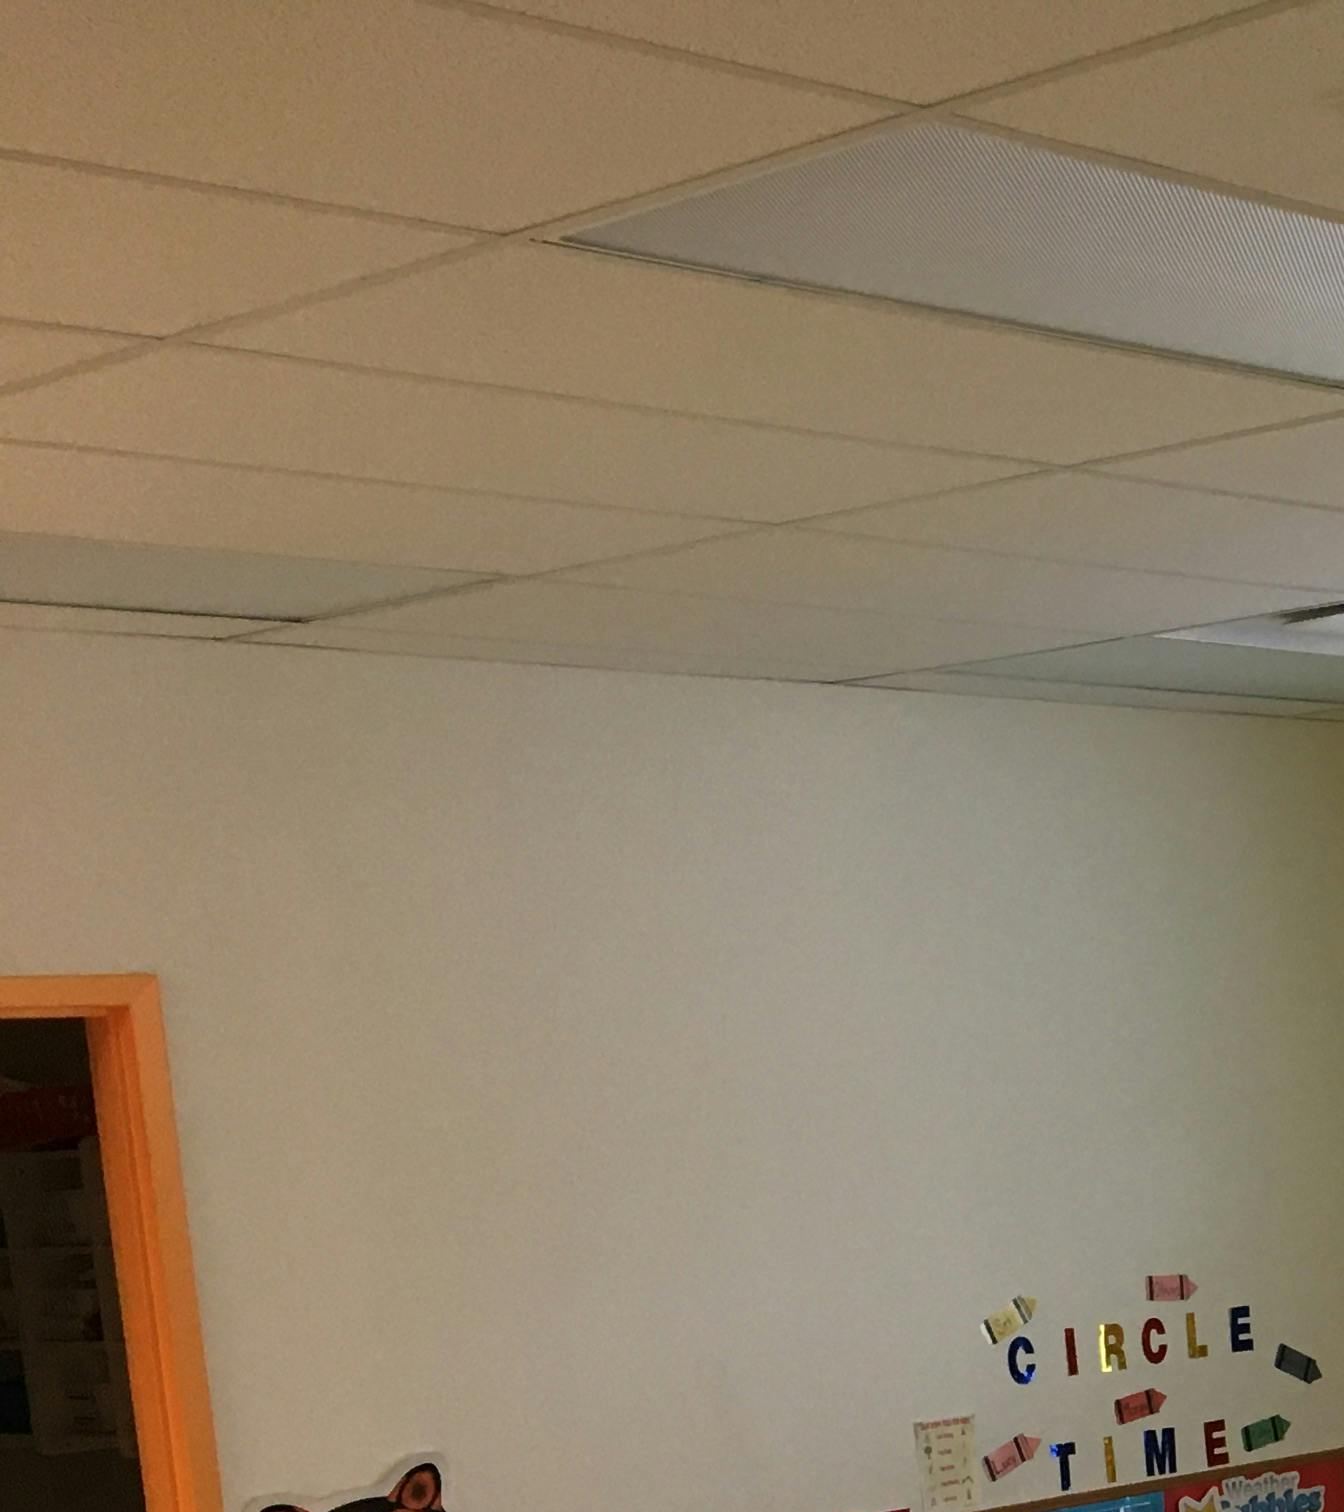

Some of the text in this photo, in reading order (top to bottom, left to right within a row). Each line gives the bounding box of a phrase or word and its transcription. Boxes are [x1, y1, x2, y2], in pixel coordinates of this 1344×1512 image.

[1008, 1305, 1254, 1384] CIRCLE
[1049, 1419, 1230, 1490] TIME
[1226, 1475, 1297, 1499] Weather
